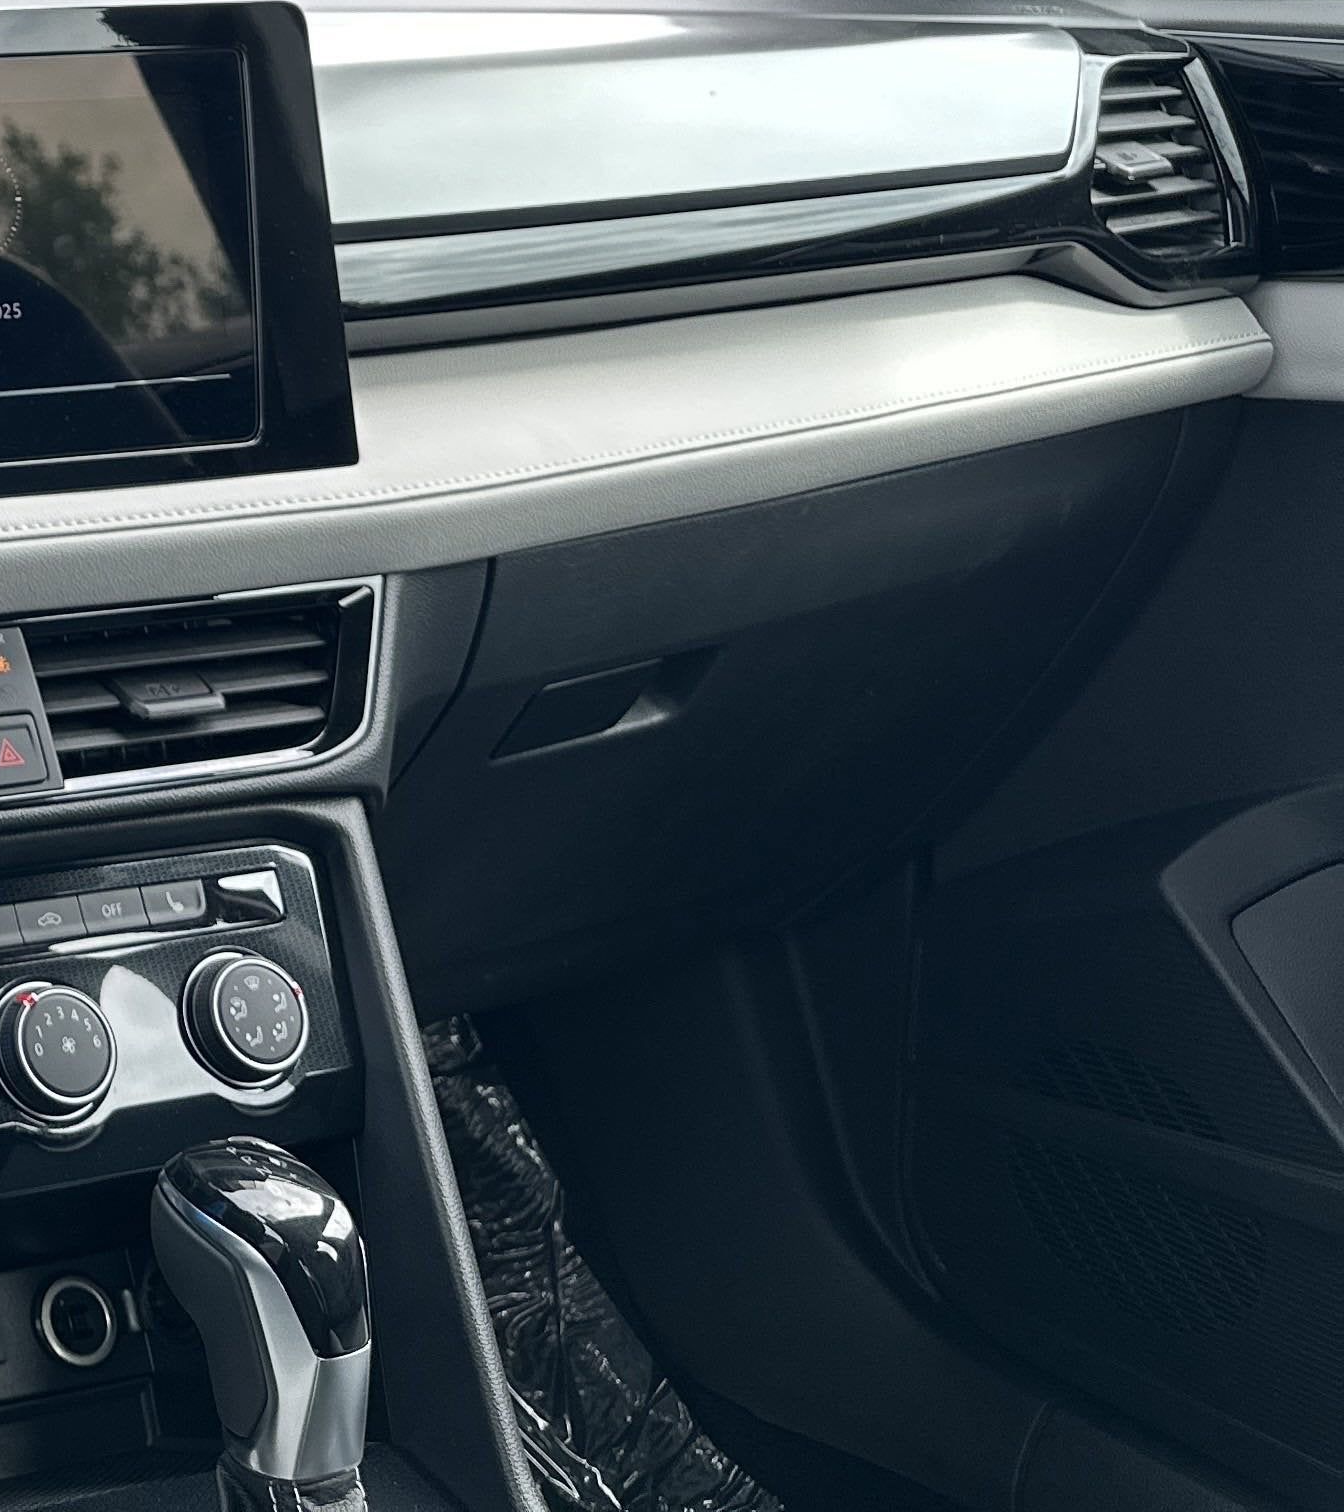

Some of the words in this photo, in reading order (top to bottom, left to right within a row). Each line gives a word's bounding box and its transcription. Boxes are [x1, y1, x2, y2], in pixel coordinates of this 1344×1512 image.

[101, 903, 122, 918] OFF
[44, 1013, 53, 1025] 2
[56, 1006, 64, 1019] 3
[71, 1009, 79, 1021] 4
[84, 1018, 92, 1031] 5
[35, 1025, 43, 1038] 1
[93, 1035, 101, 1048] 6
[35, 1043, 43, 1056] 0
